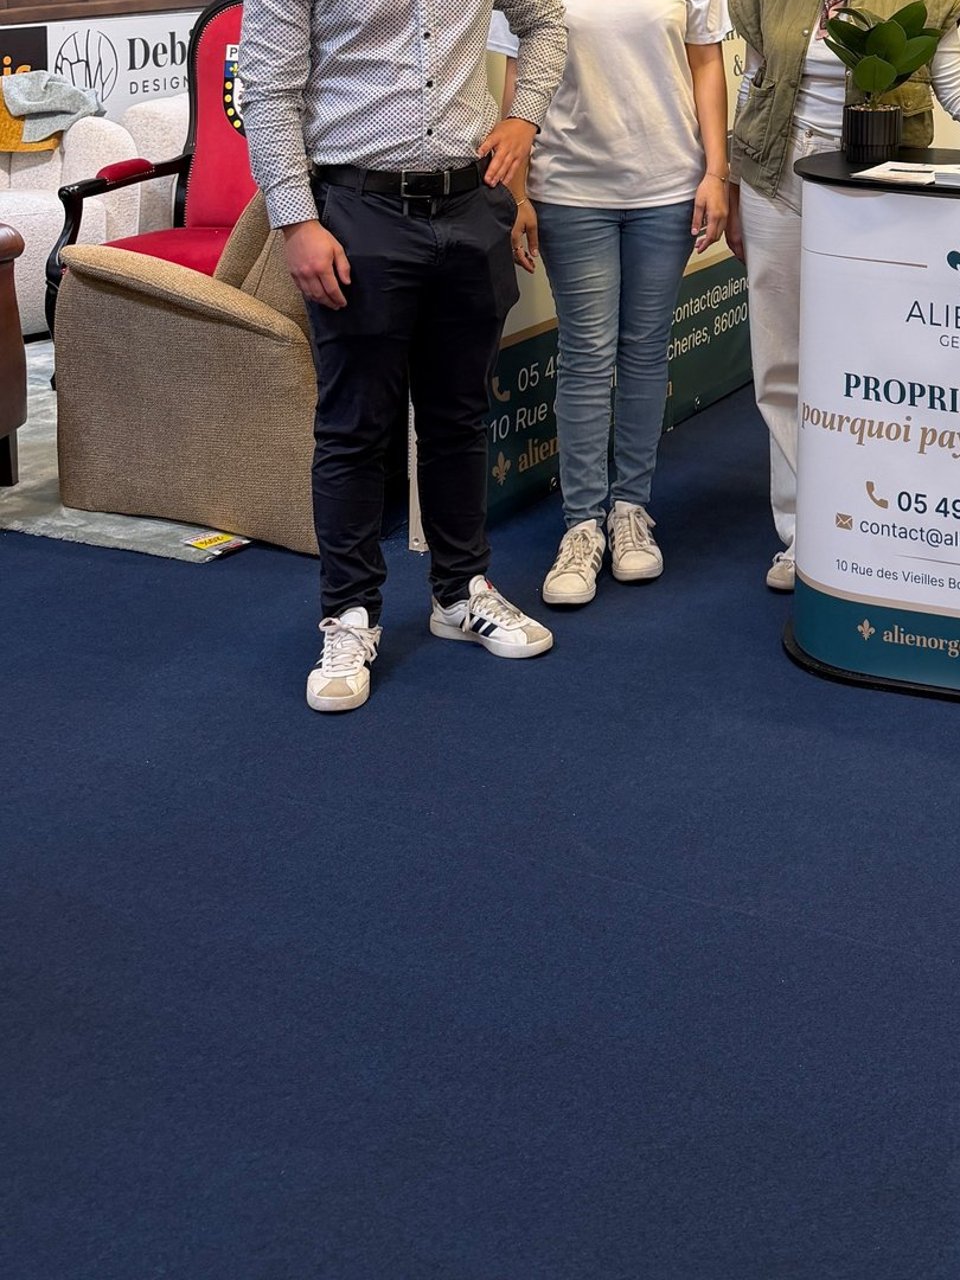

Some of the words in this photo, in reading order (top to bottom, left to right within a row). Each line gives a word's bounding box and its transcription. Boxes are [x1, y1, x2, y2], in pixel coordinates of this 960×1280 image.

[713, 301, 748, 337] 86000
[517, 362, 540, 393] 05
[544, 354, 561, 380] 4
[490, 414, 510, 444] 10
[515, 402, 549, 433] Rue
[801, 401, 912, 447] pourquoi
[897, 490, 928, 515] 05
[835, 557, 849, 573] 10
[851, 561, 874, 578] Rue
[876, 564, 899, 582] des
[902, 568, 945, 589] Vieilles
